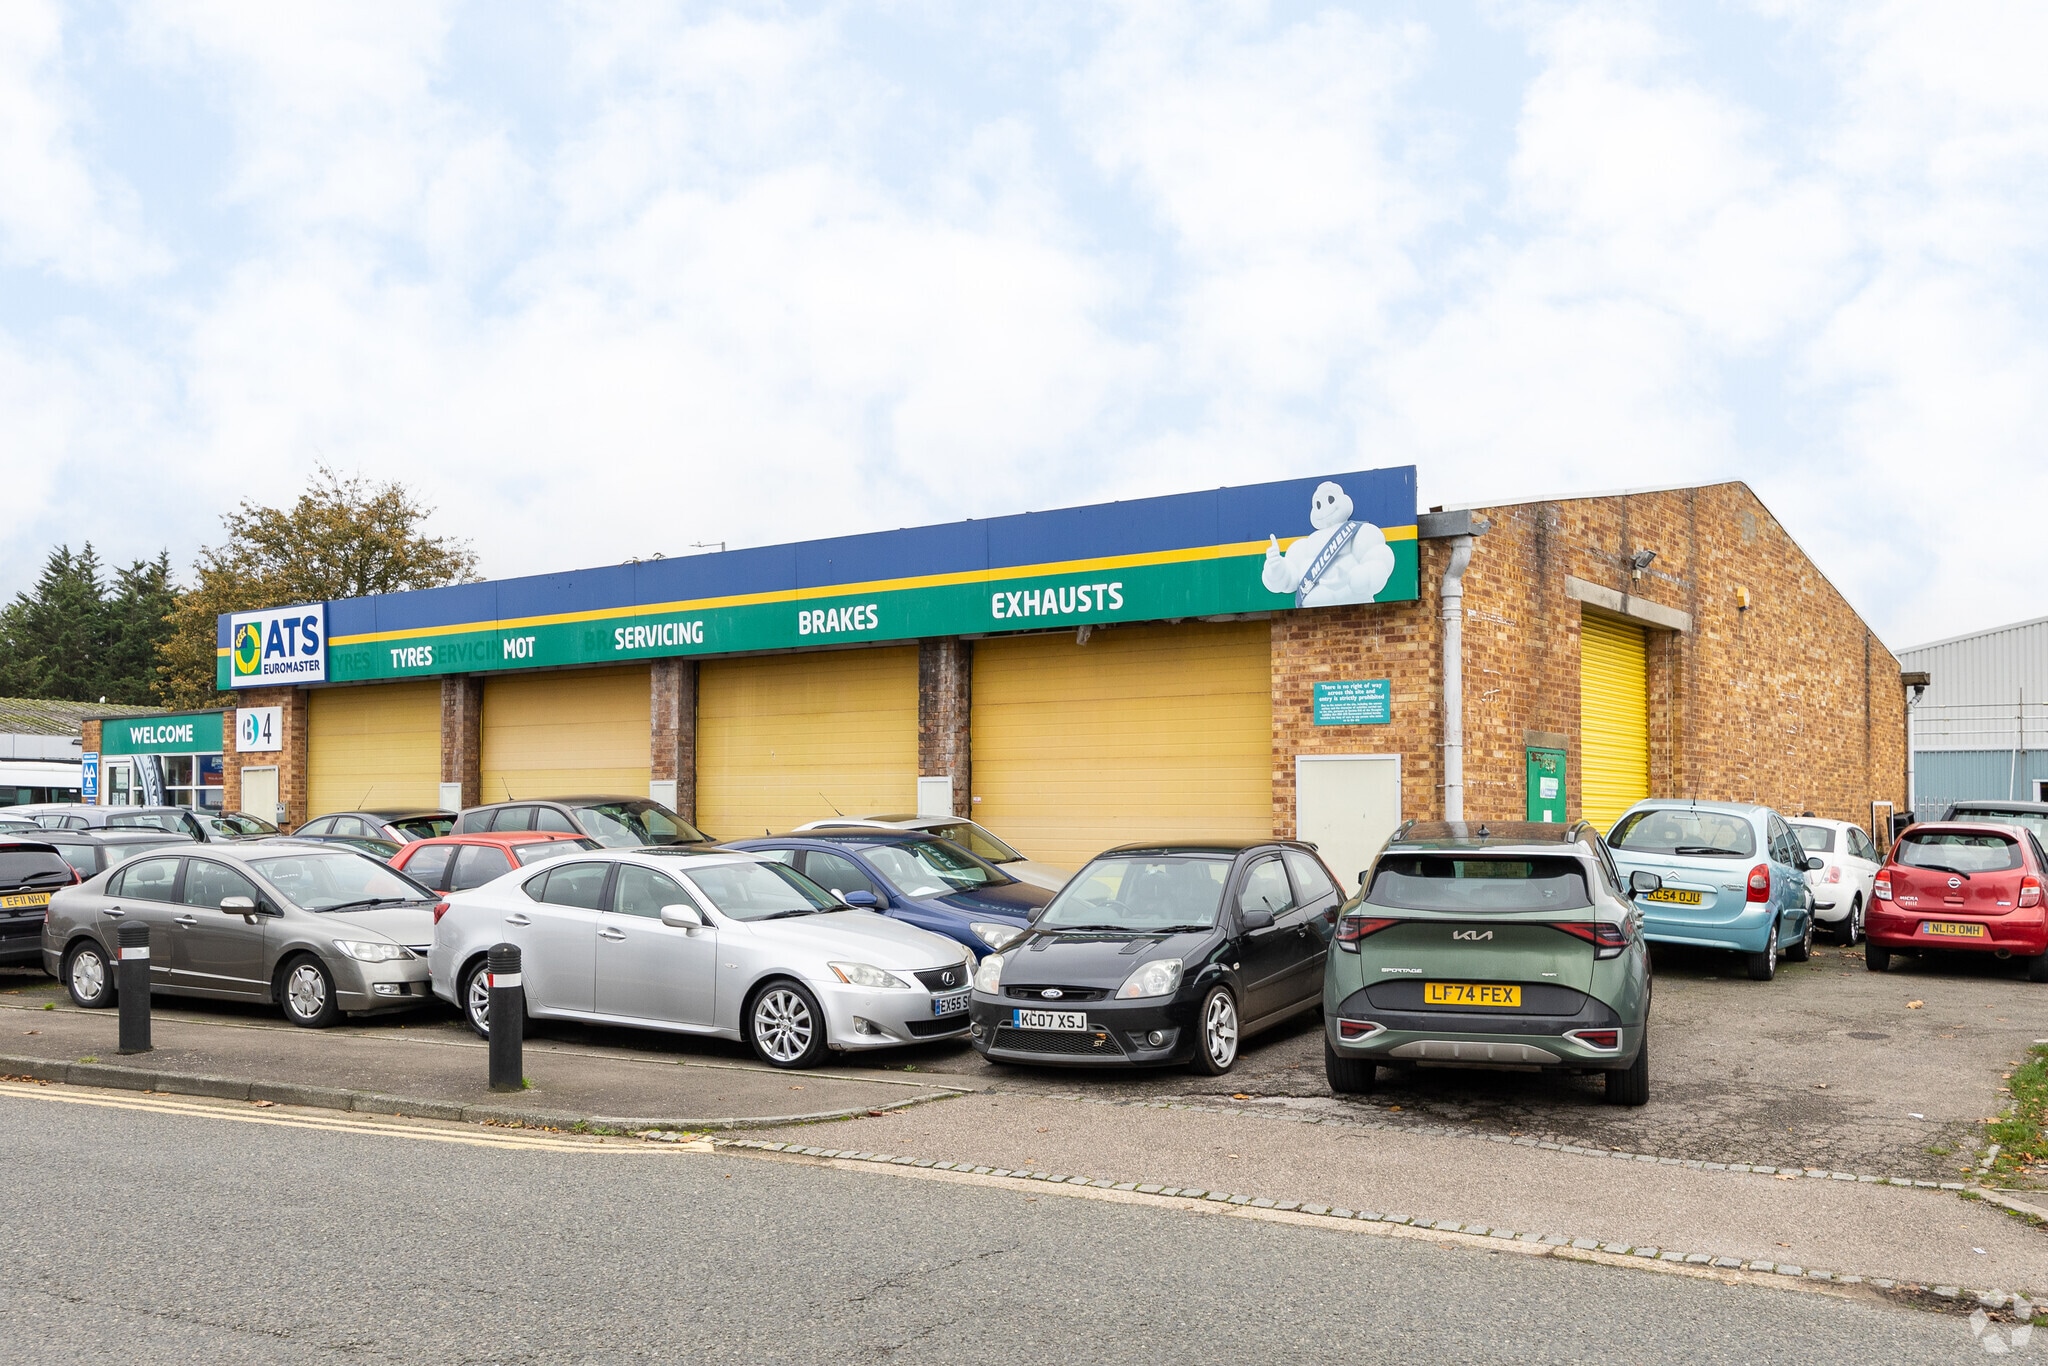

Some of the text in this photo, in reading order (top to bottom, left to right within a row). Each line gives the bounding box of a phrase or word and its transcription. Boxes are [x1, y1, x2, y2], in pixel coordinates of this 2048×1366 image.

[1311, 522, 1356, 578] MICHELIN
[991, 582, 1124, 619] EXHAUSTS
[798, 604, 878, 635] BRAKES
[264, 615, 319, 659] ATS
[614, 621, 703, 650] SERVICING
[390, 645, 433, 668] TYRES
[503, 637, 536, 660] MOT
[263, 660, 320, 675] EUROMASTER
[335, 651, 371, 672] YRES
[130, 724, 193, 744] WELCOME
[263, 712, 272, 744] 4
[28, 895, 46, 904] NHV
[1679, 891, 1700, 902] OJU
[1932, 924, 1980, 935] NL13 OMH
[941, 997, 961, 1012] EX55
[1432, 985, 1513, 1003] LF74 FEX
[1021, 1012, 1084, 1028] KC07 XSJ
